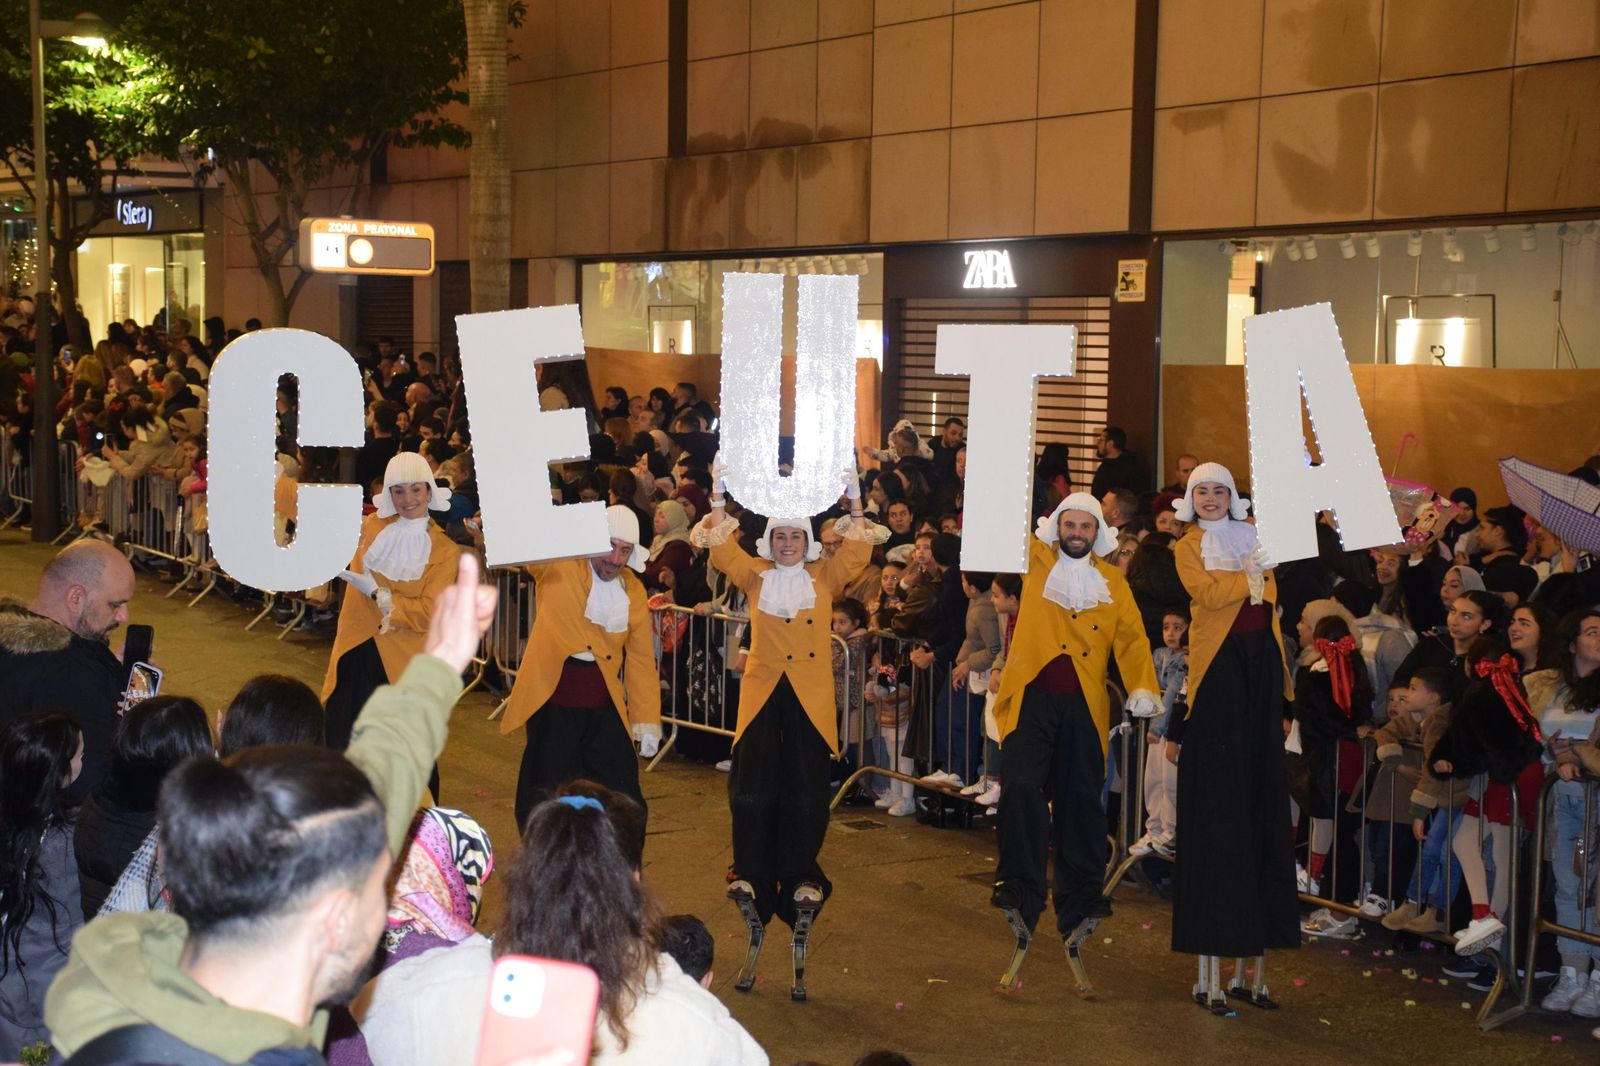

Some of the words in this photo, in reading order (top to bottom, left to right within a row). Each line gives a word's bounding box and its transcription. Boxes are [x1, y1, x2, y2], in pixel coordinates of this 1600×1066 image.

[328, 222, 358, 233] ZONA
[363, 224, 417, 236] PEATONAL
[963, 249, 1017, 288] ZARA
